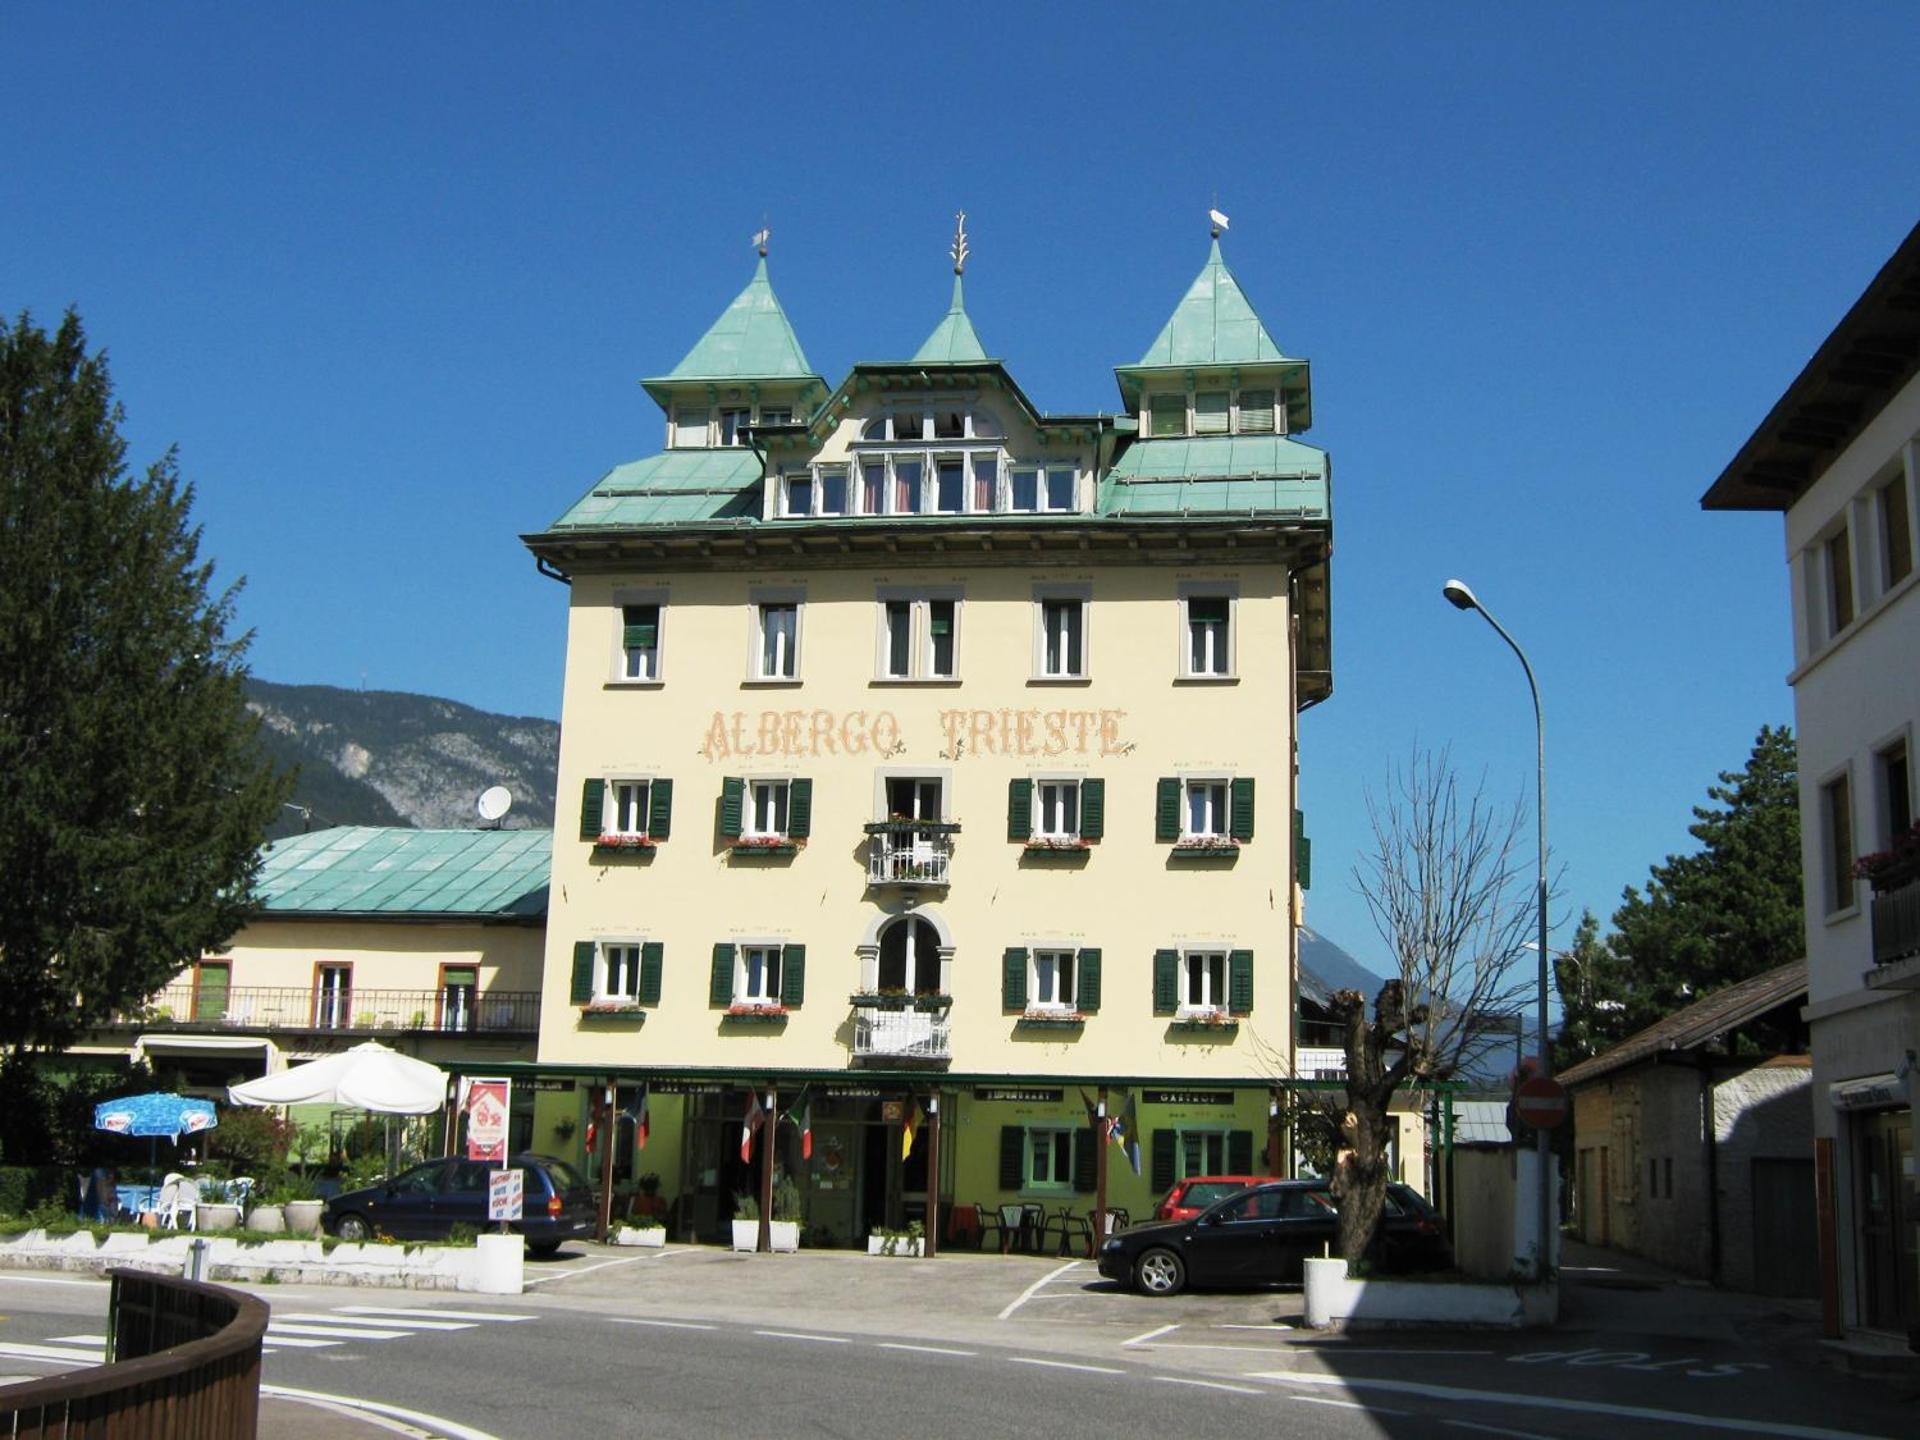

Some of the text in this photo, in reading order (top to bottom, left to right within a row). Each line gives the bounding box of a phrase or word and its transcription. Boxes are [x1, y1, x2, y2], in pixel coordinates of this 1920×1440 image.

[703, 707, 1128, 761] ALBERGO TRIESTE
[1159, 1092, 1217, 1103] GASTHOF
[1505, 1348, 1771, 1376] STOP
